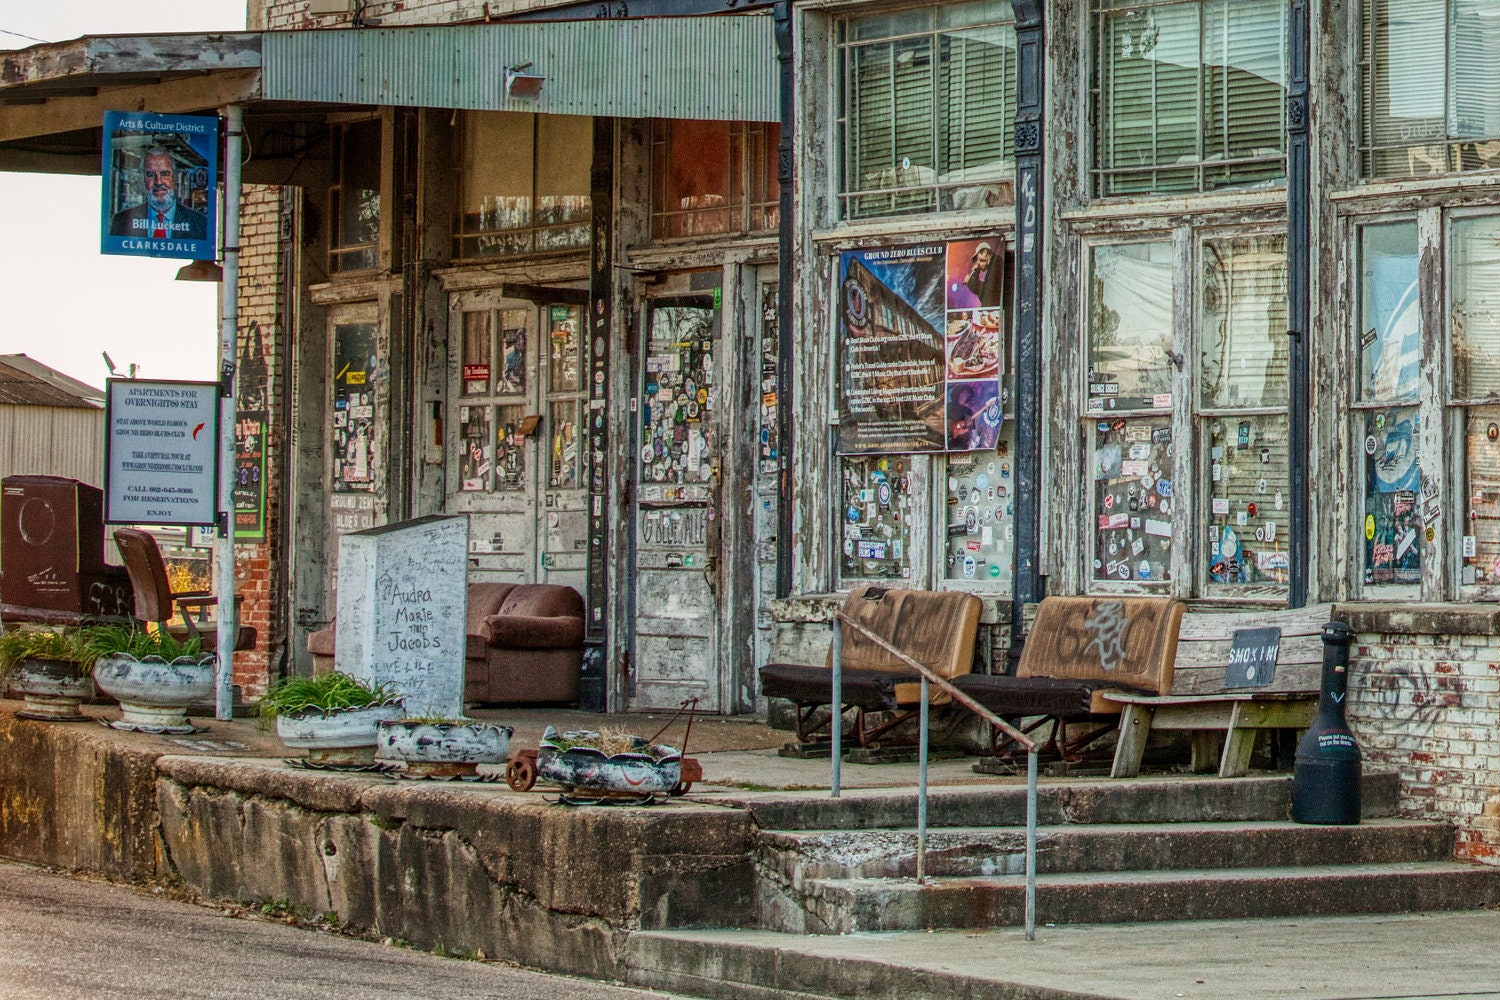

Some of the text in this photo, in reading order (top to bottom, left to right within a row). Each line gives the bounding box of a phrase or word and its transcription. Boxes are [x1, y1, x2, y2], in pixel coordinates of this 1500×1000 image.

[119, 119, 204, 133] Arts & Culture District
[132, 219, 190, 232] Bill Luckett
[122, 240, 197, 252] CLARKSDALE
[864, 246, 942, 260] GROUND ZERO BLUES CLUB
[128, 388, 180, 398] APARTMENTS
[180, 400, 199, 408] STAY
[141, 496, 199, 504] RESERVATIONS
[391, 584, 433, 605] Audra
[395, 607, 433, 624] Marie
[388, 632, 441, 652] Jacobs
